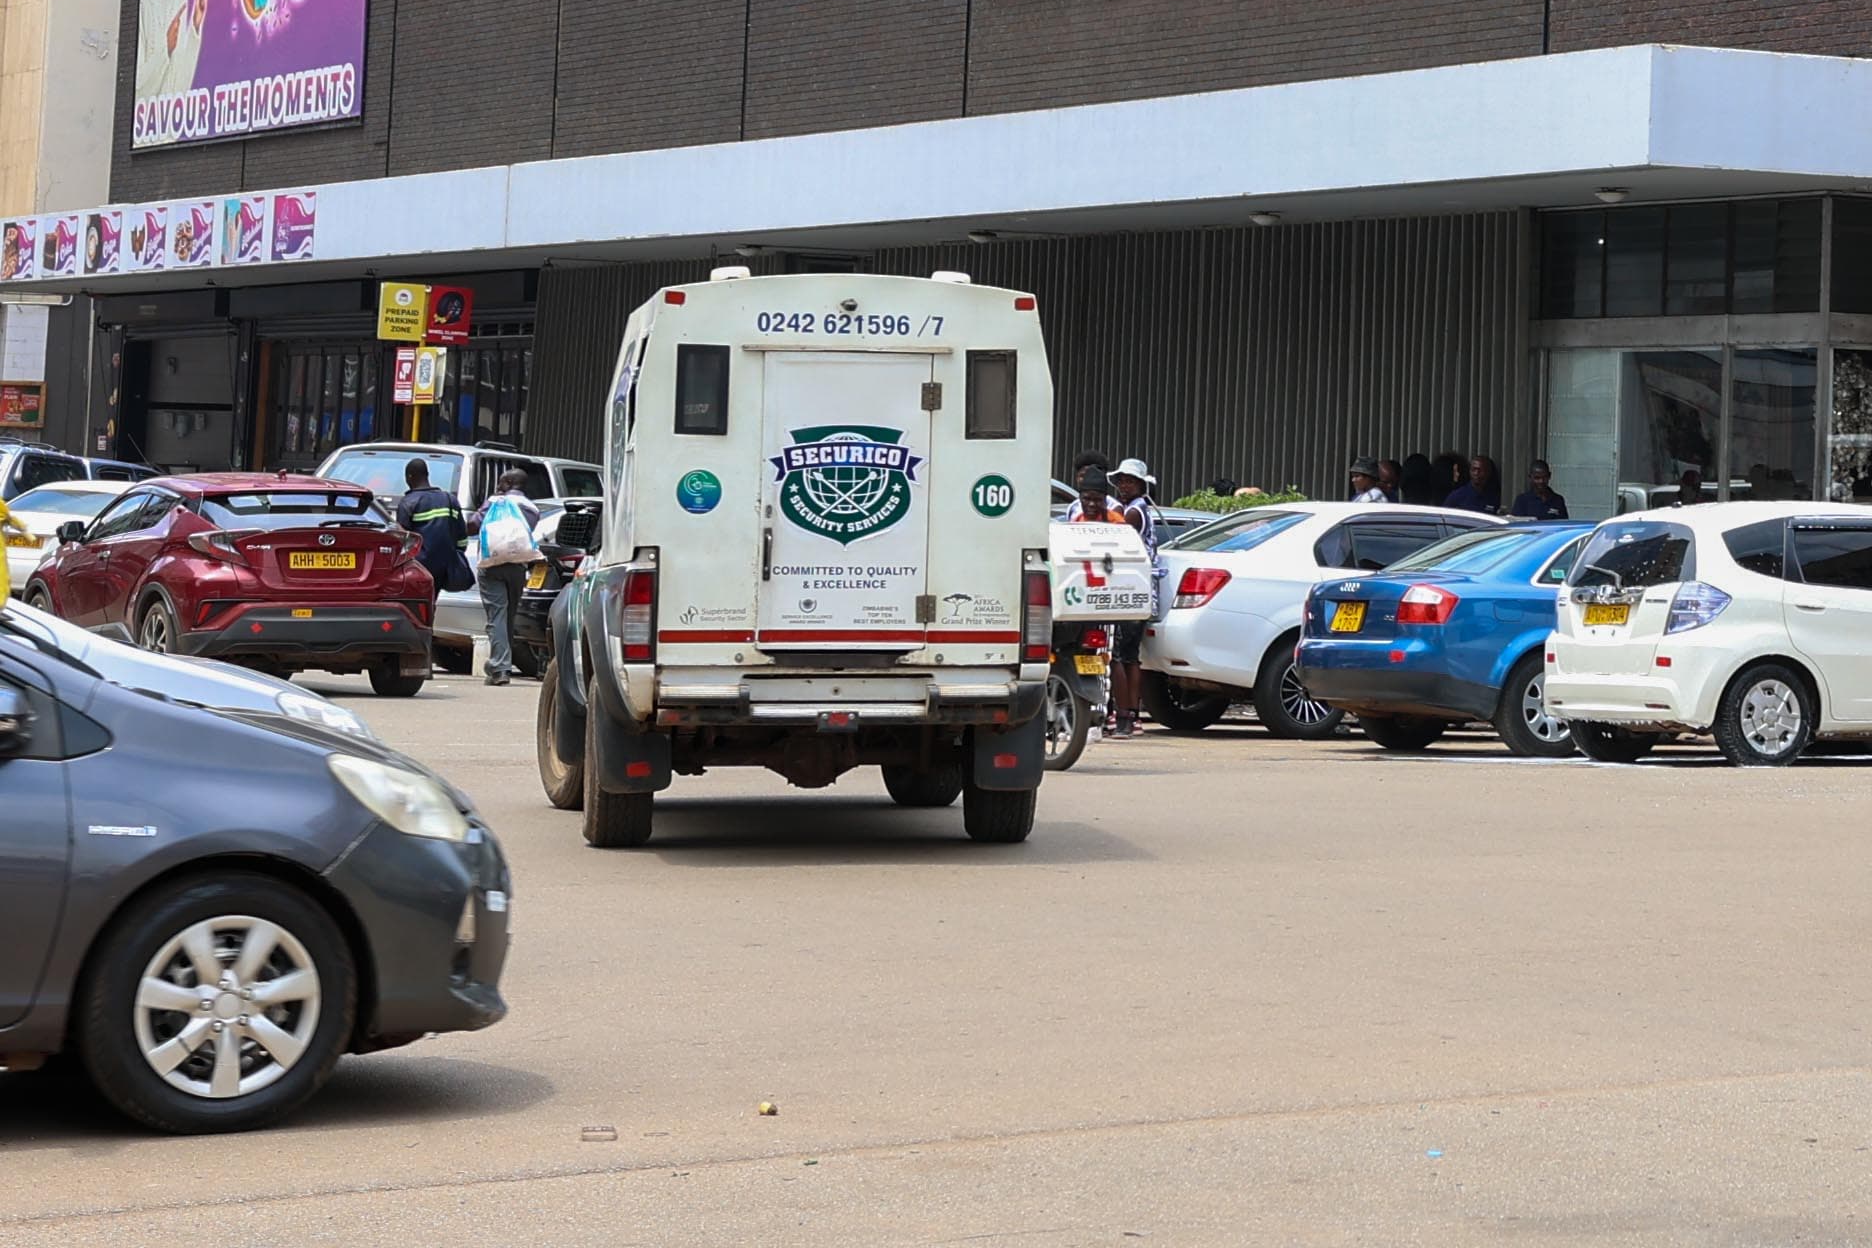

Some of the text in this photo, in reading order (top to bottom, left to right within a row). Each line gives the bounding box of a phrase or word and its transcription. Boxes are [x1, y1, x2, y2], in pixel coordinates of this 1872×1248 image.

[134, 63, 356, 144] SAVOUR THE MOMENTS
[385, 307, 419, 317] PREPAID
[384, 316, 419, 325] PARKING
[757, 311, 816, 334] 0242
[823, 312, 911, 336] 621596
[390, 325, 412, 334] ZONE
[790, 445, 902, 467] SECURICO
[975, 484, 1010, 507] 160
[789, 494, 901, 533] SECURITY SERVICES
[292, 554, 351, 567] AHH 5003
[772, 565, 918, 578] COMMITTED TO QUALITY
[802, 579, 887, 590] & EXCELLENCE
[701, 607, 747, 617] Superbrand
[700, 615, 726, 623] Security
[941, 617, 964, 625] Grand
[965, 617, 983, 625] Prize
